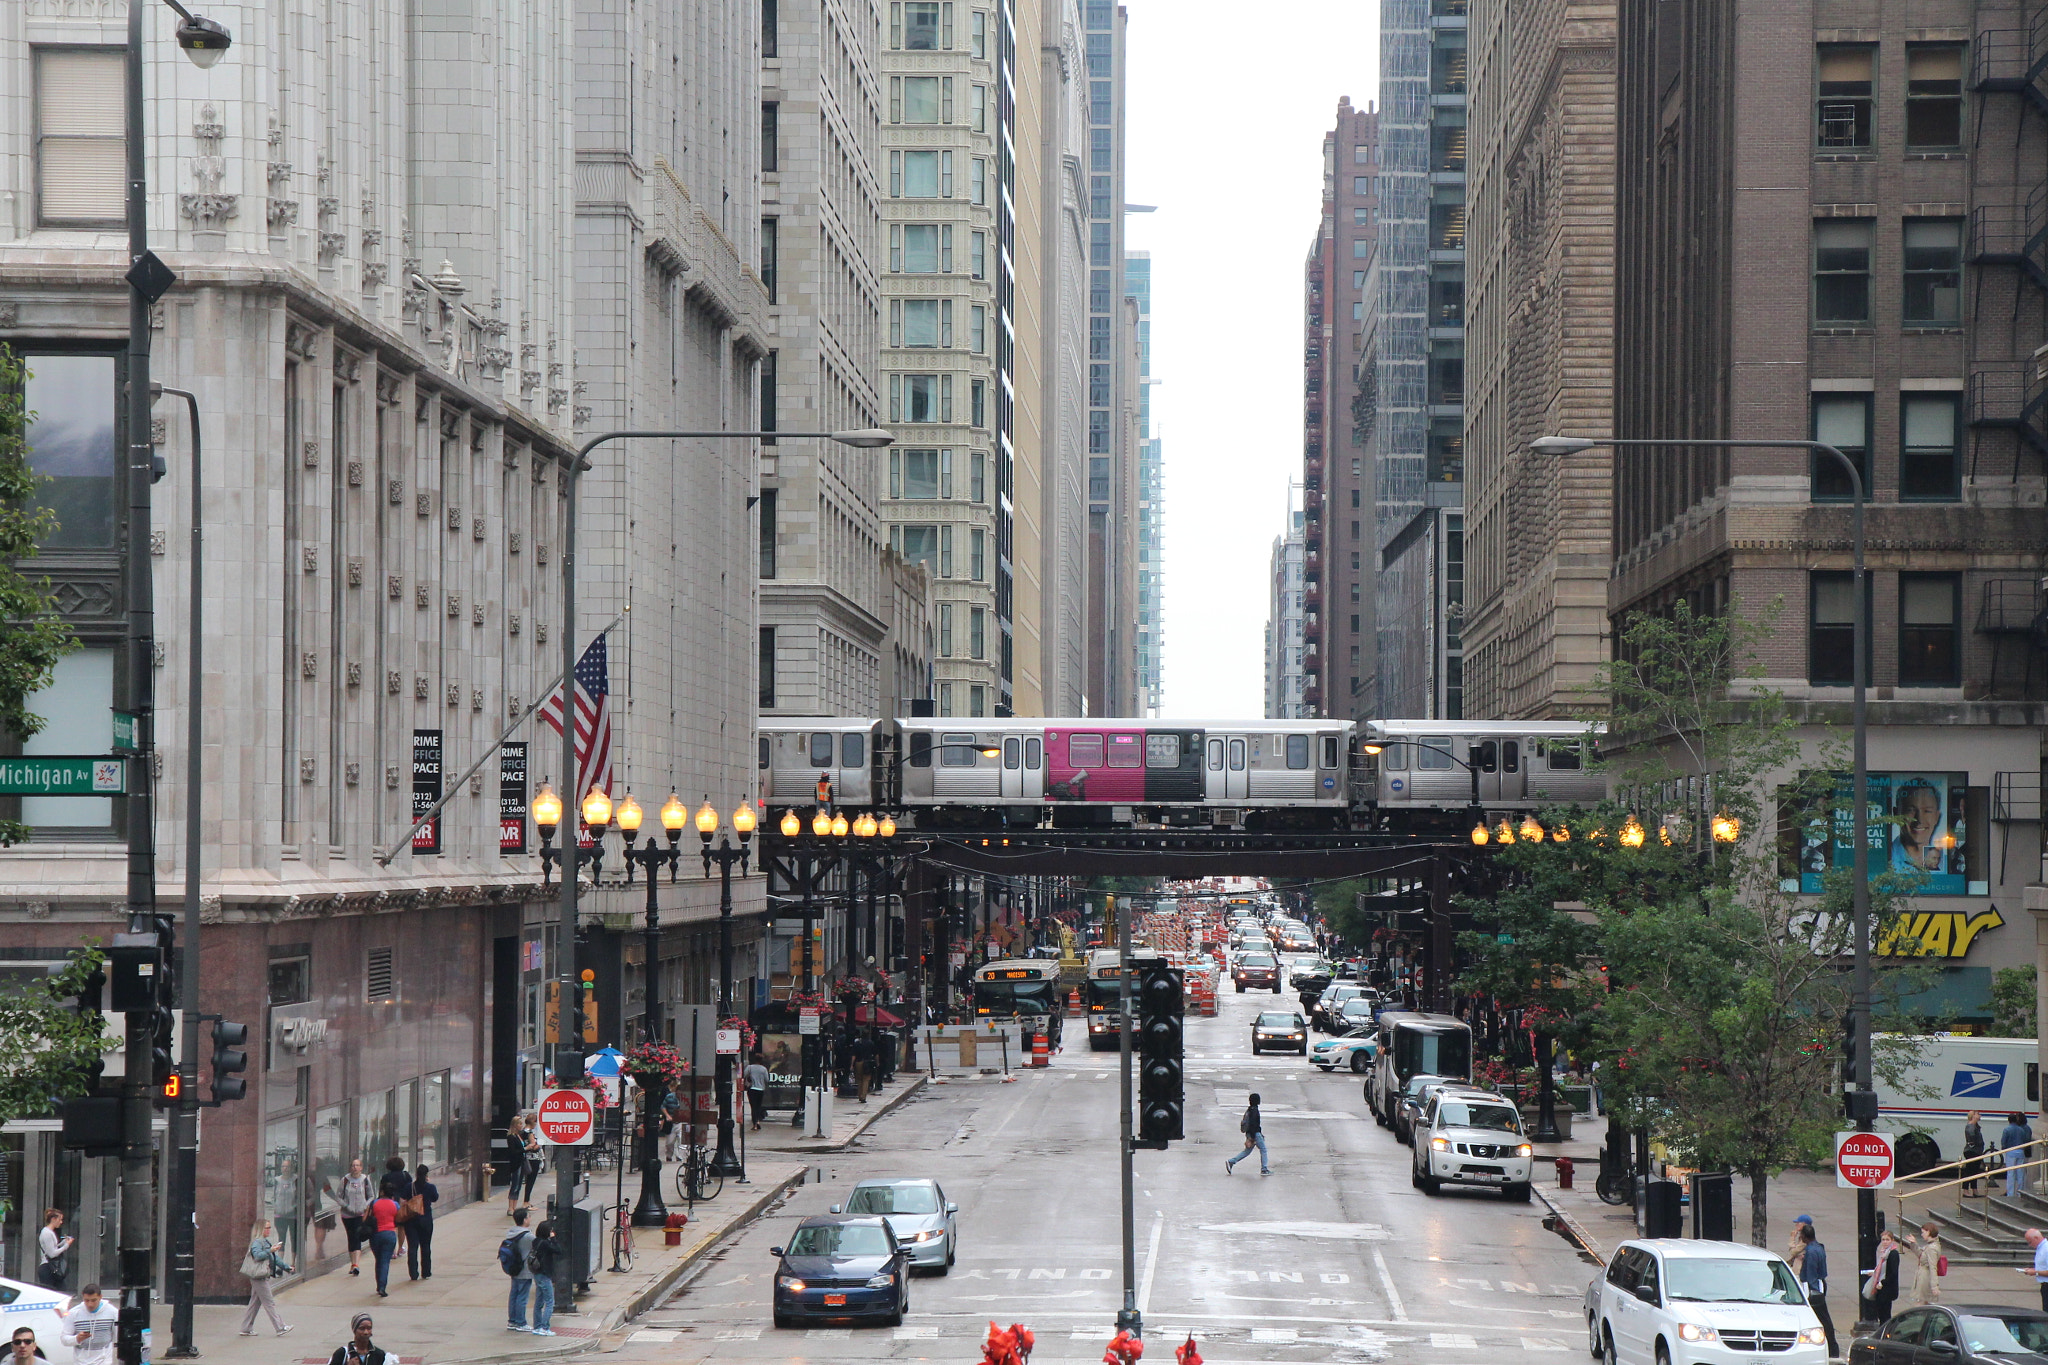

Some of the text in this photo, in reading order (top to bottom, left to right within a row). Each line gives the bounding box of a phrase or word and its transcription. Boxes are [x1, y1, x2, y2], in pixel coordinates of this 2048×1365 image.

[413, 736, 439, 747] RIME
[414, 750, 440, 760] FFICE
[501, 748, 524, 757] RIME
[413, 763, 439, 773] PACE
[501, 760, 526, 769] FFICE
[0, 764, 88, 791] Michigan Av
[501, 772, 524, 781] PACE
[412, 792, 432, 800] (312)
[501, 797, 518, 806] (312)
[987, 971, 996, 980] 20
[546, 1100, 585, 1110] DO NOT
[550, 1124, 580, 1134] ENTER
[1846, 1144, 1885, 1154] DO NOT
[1849, 1168, 1881, 1178] ENTER
